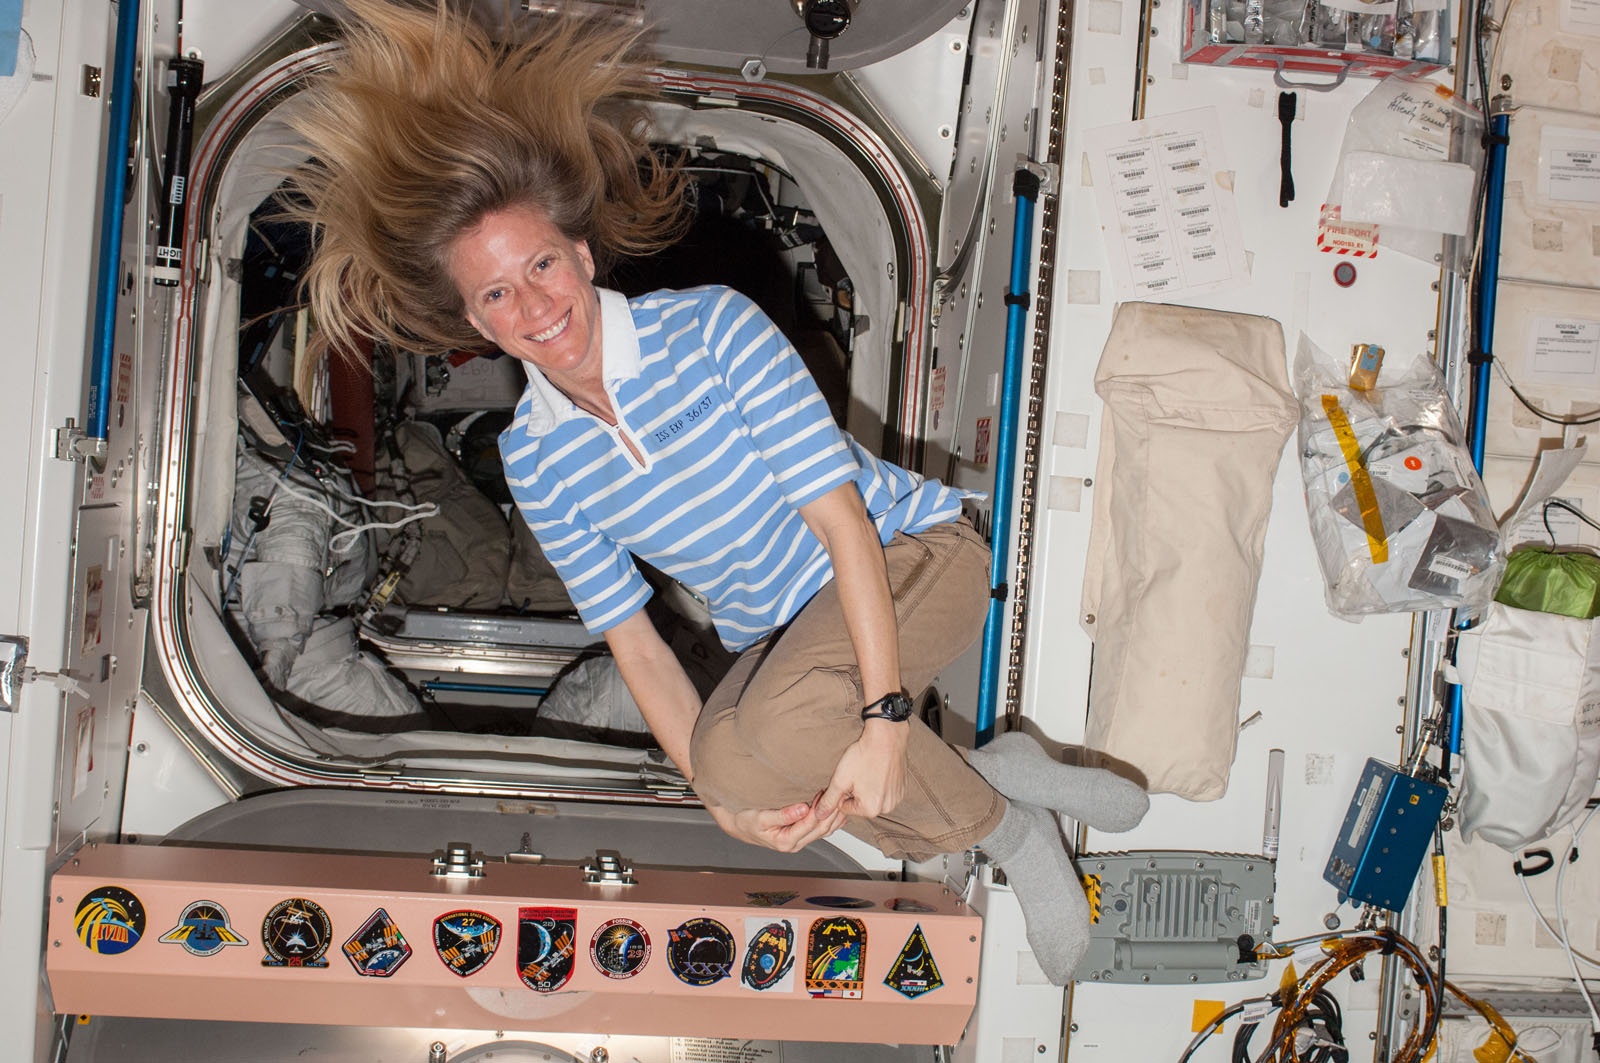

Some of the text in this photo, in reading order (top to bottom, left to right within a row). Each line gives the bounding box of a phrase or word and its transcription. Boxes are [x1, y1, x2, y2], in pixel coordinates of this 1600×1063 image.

[1348, 227, 1372, 239] PORT
[655, 396, 712, 443] ISS EXP 36/37
[461, 918, 475, 927] 27
[627, 950, 644, 959] 29
[289, 956, 301, 967] 25
[681, 961, 731, 977] XXX
